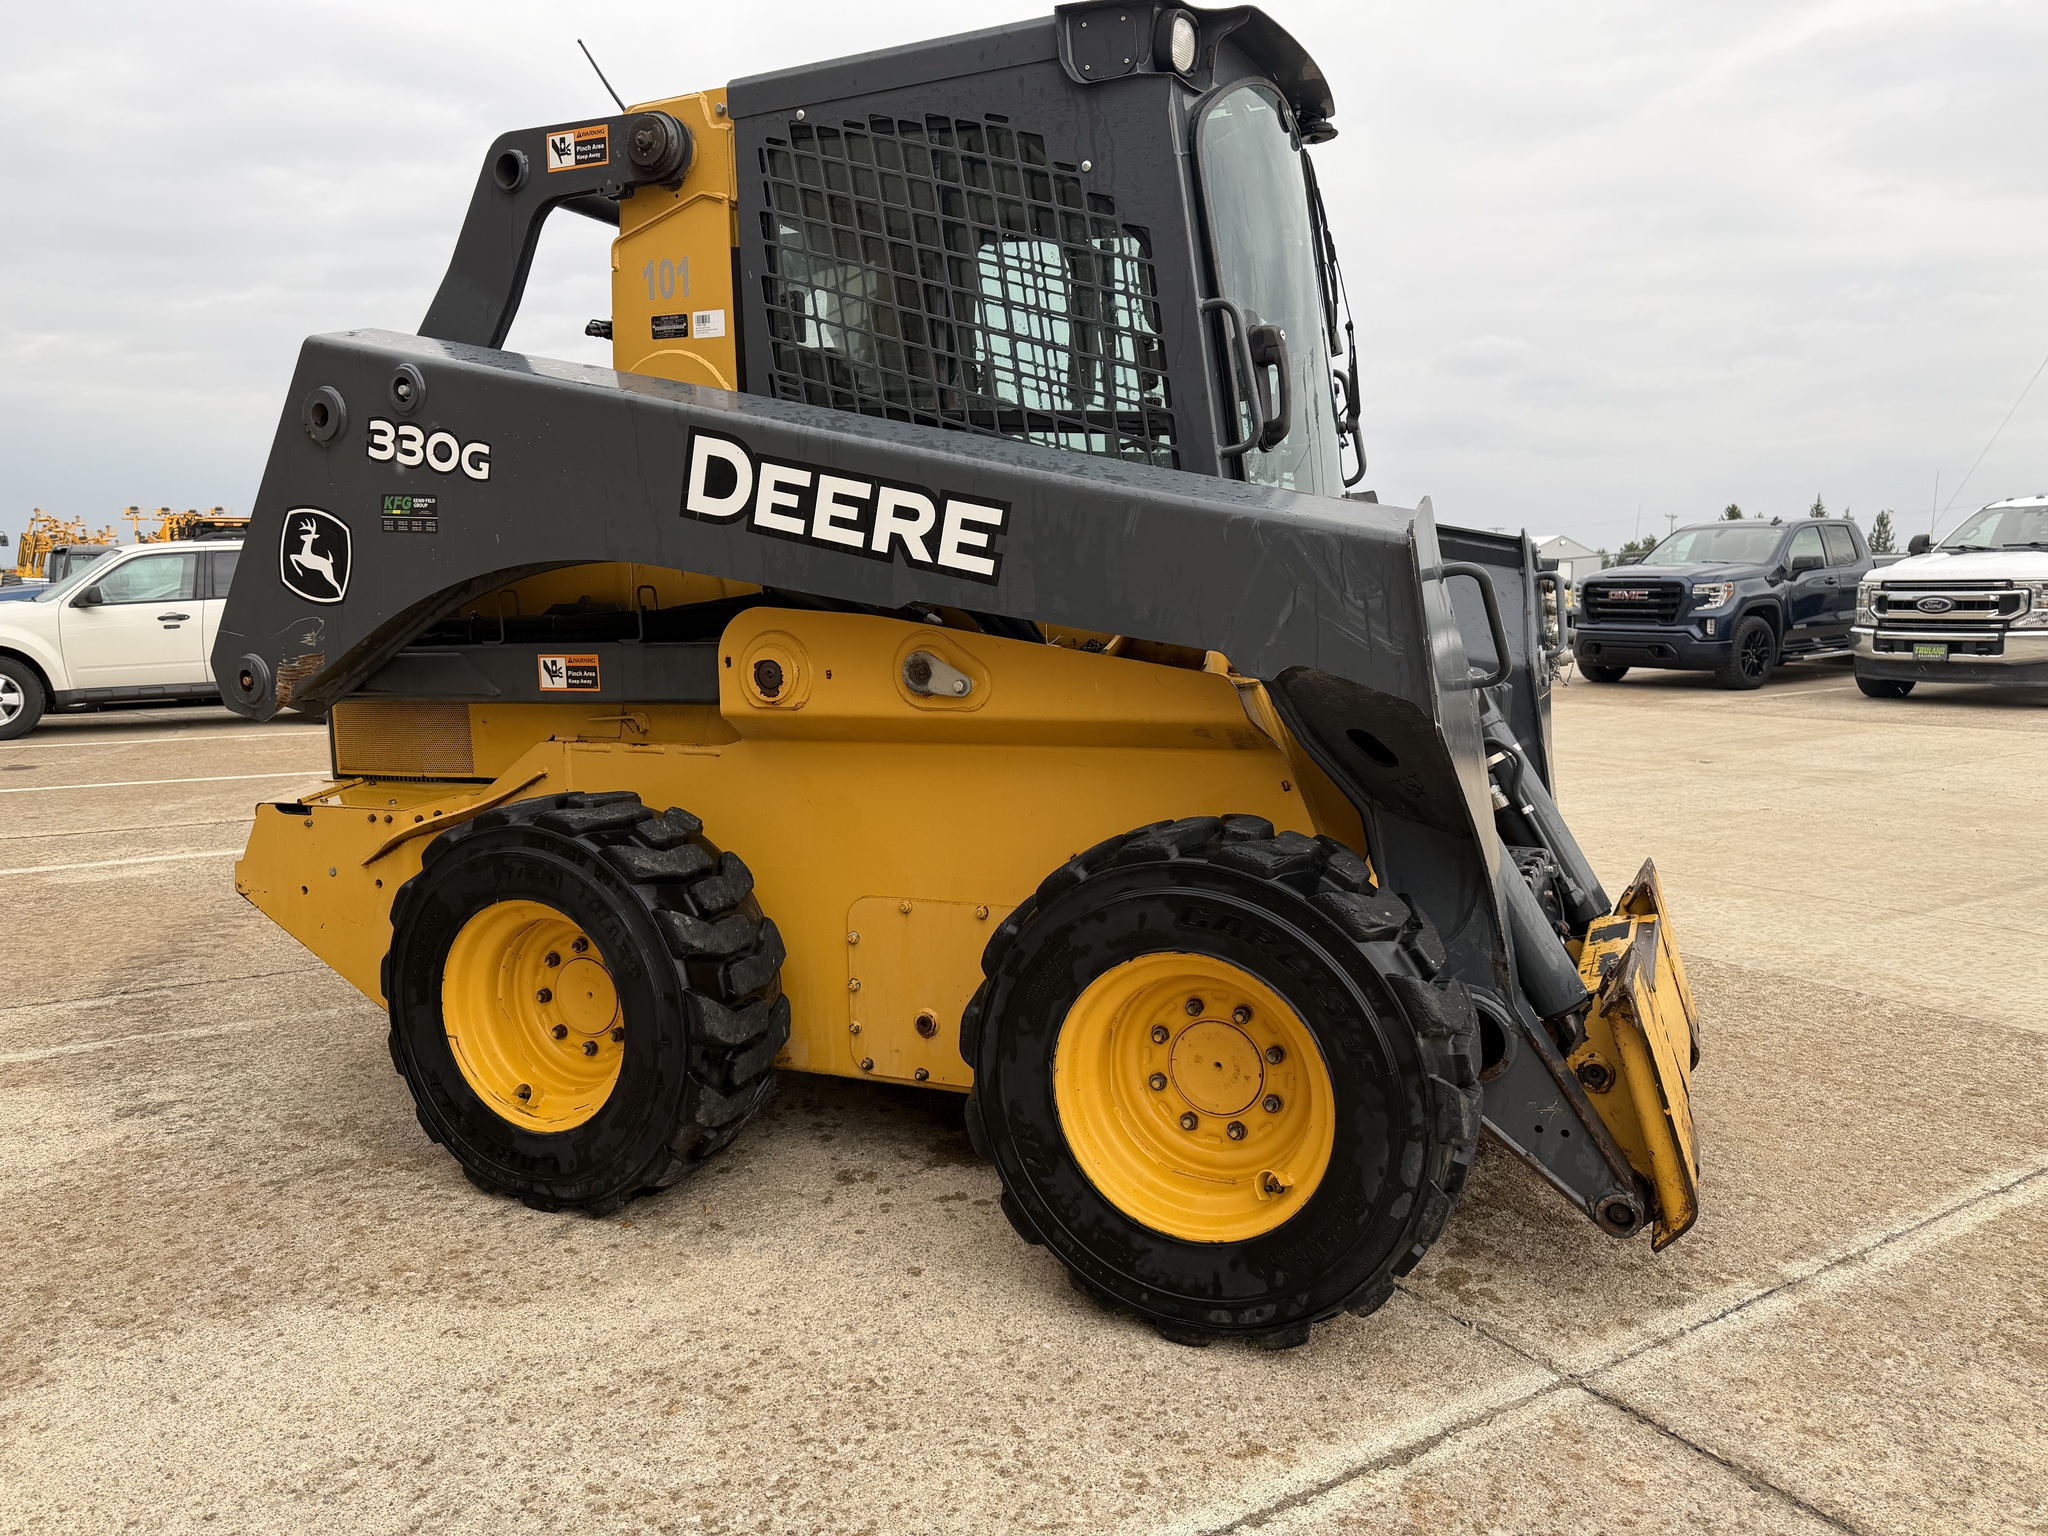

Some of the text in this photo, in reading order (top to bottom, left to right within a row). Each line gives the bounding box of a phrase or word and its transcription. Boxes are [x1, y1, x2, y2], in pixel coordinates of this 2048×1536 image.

[582, 129, 605, 137] WARNING
[643, 255, 690, 300] 101
[368, 419, 490, 480] 330G
[384, 496, 412, 509] KFG
[686, 434, 1003, 576] DEERE
[1608, 591, 1649, 600] GMC
[1915, 646, 1945, 655] TRULAND
[1176, 903, 1379, 1080] CARLISLE
